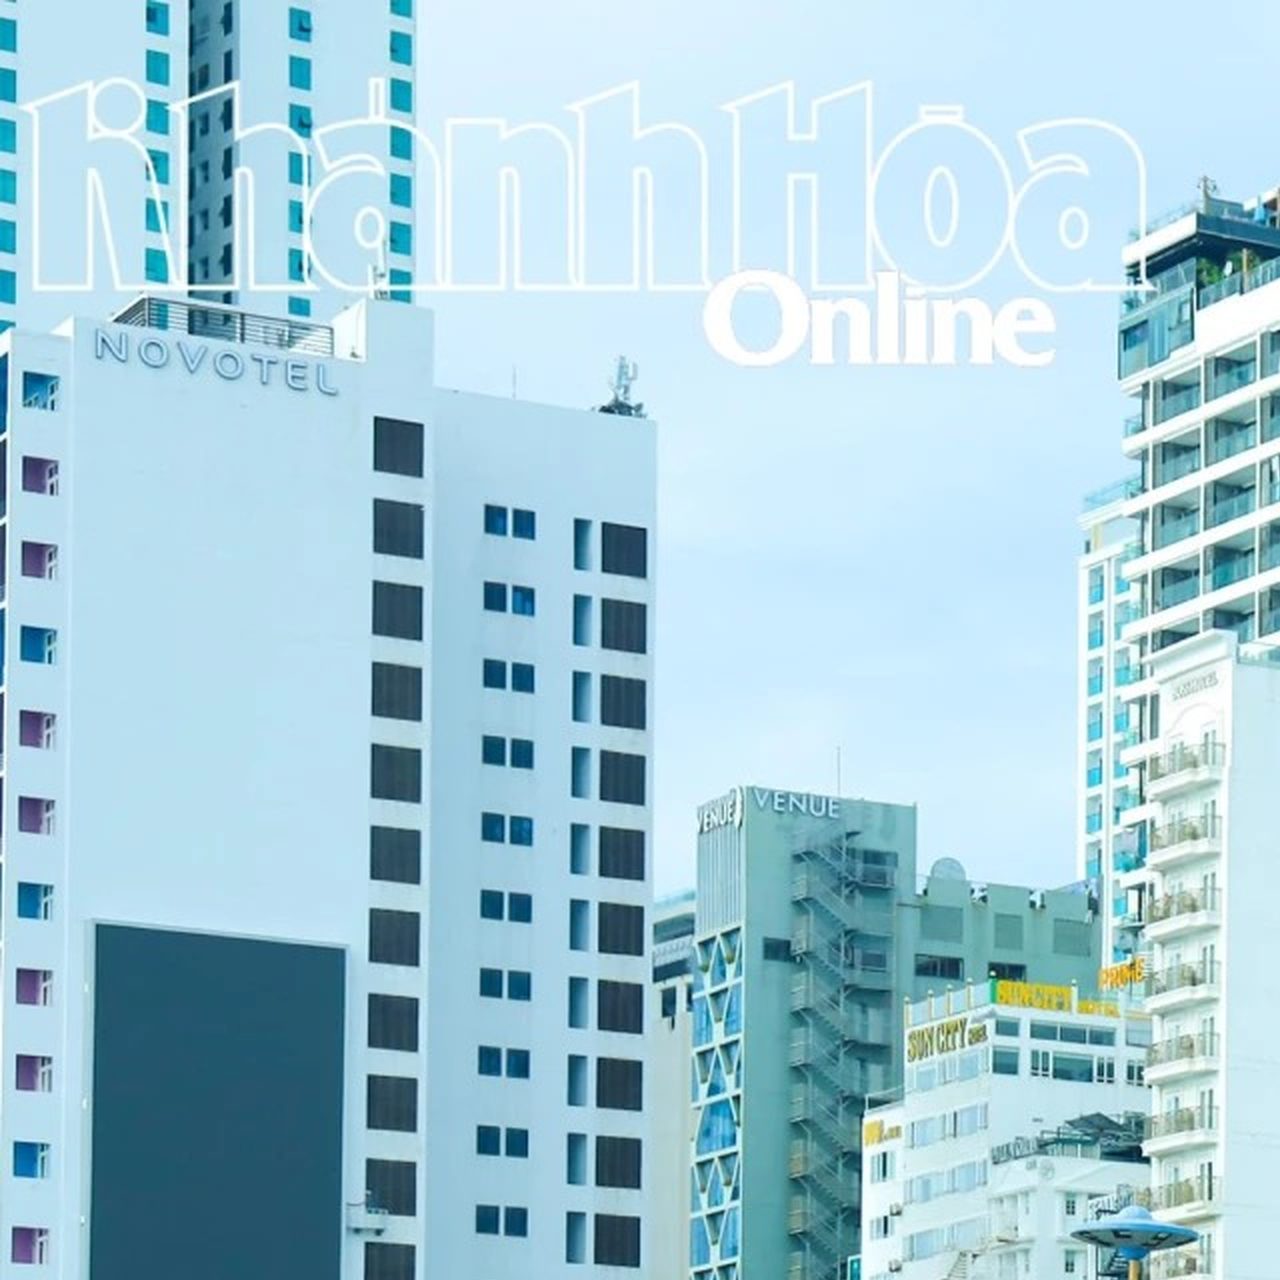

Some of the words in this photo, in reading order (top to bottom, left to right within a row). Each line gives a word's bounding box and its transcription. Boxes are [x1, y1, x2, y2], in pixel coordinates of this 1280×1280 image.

[93, 326, 340, 397] NOVOTEL
[752, 787, 841, 820] VENUE
[907, 1027, 935, 1063] SUN
[936, 1017, 968, 1056] CITY
